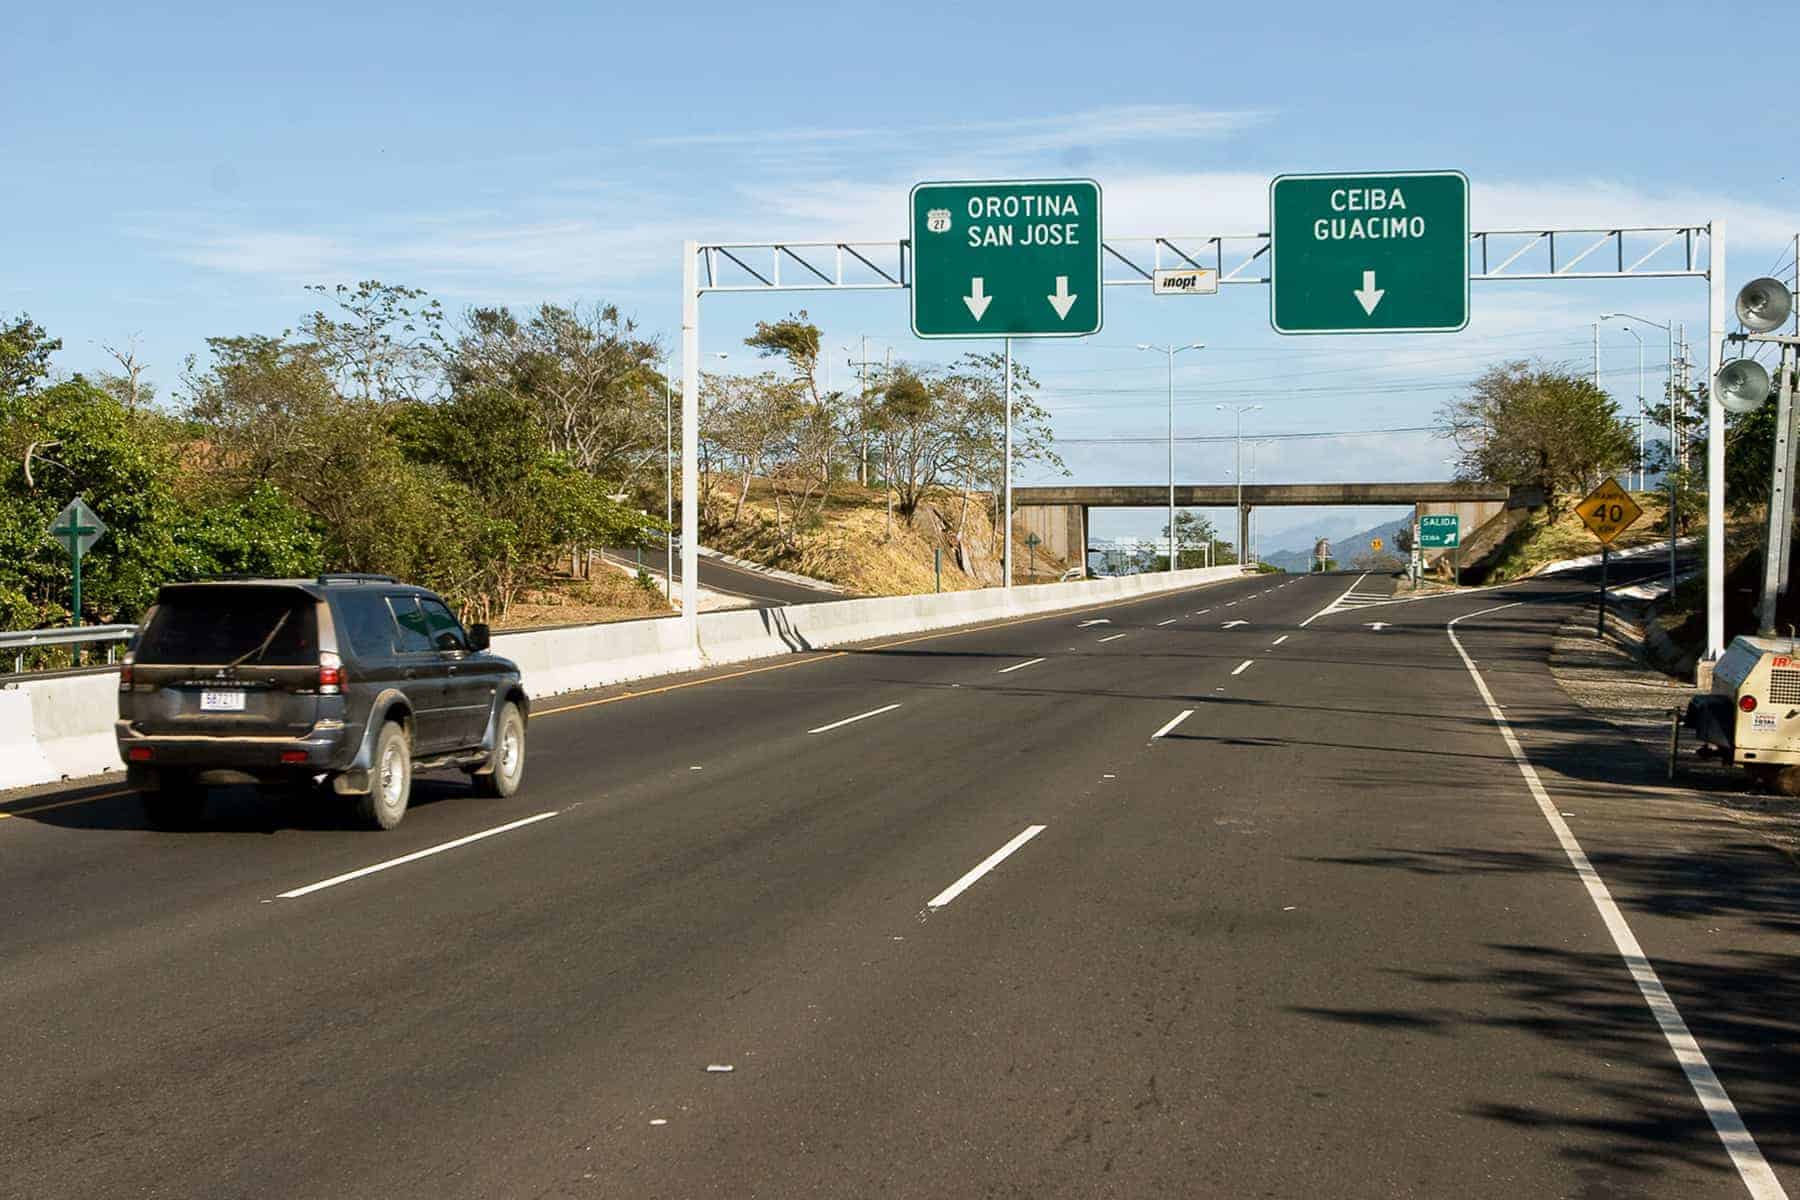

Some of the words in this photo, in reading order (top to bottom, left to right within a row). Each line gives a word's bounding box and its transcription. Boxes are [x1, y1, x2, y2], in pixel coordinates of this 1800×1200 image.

[967, 195, 1079, 218] OROTINA
[1330, 188, 1406, 211] CEIBA
[933, 219, 945, 230] 27
[1314, 216, 1425, 240] GUACIMO
[967, 225, 1013, 247] SAN
[1020, 224, 1079, 246] JOSE
[1162, 274, 1197, 290] inopt
[1423, 518, 1457, 526] SALIDA
[1592, 504, 1623, 522] 40
